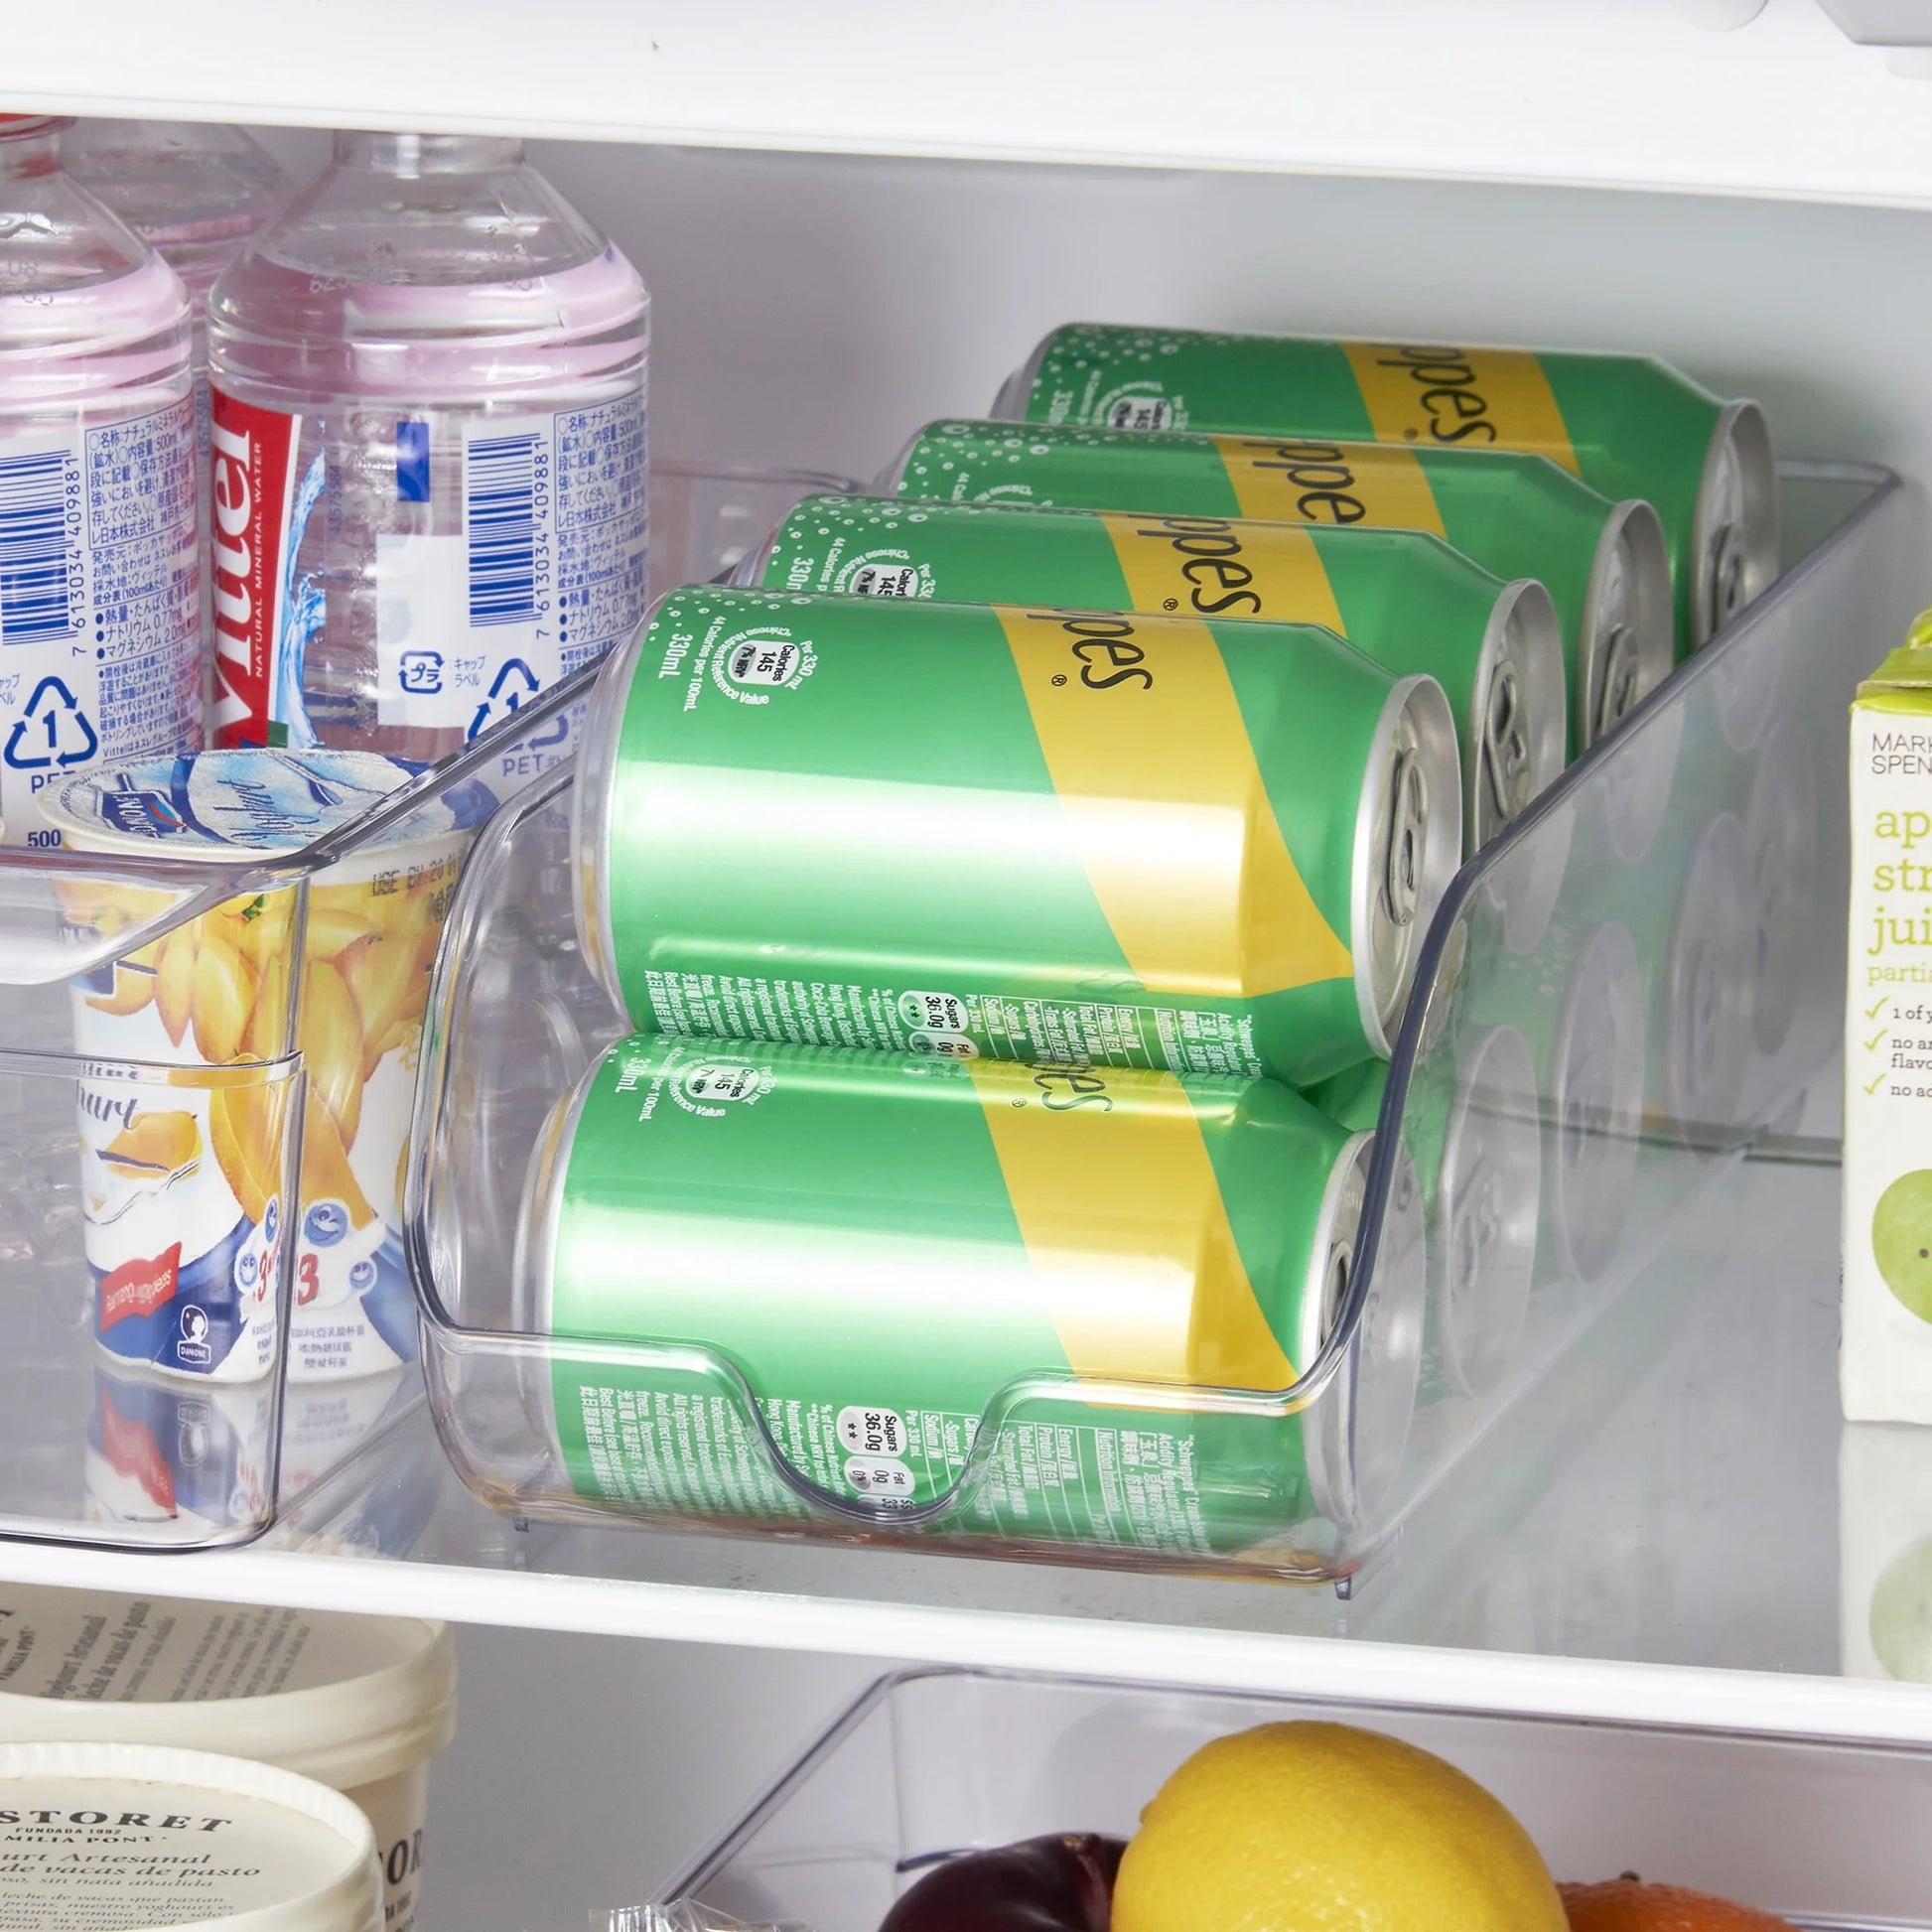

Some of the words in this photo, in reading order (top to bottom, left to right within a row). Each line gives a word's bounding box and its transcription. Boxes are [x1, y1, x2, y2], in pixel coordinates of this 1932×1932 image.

[253, 442, 263, 504] WATER
[534, 441, 549, 519] 409881
[65, 458, 82, 536] 409881
[254, 510, 264, 591] MINERAL
[535, 532, 550, 613] 613034
[69, 549, 86, 629] 613034
[106, 618, 151, 643] ナトリウム
[254, 596, 265, 679] NATURAL
[536, 628, 550, 639] 7
[698, 625, 722, 658] Calories
[72, 646, 86, 658] 7
[106, 631, 162, 658] マグネシウム
[658, 633, 693, 679] 330mL
[410, 661, 440, 683] プラ
[454, 655, 486, 672] キャップ
[693, 658, 706, 676] per
[757, 651, 777, 673] 145
[772, 645, 795, 682] Calories
[798, 654, 818, 677] 330
[455, 672, 482, 687] ラベル
[711, 659, 740, 700] Reference
[740, 691, 769, 705] Value
[683, 677, 703, 712] 100mL
[502, 754, 545, 777] PET
[28, 828, 63, 848] 500
[1874, 810, 1932, 849] ap
[1866, 905, 1932, 956] jui
[664, 971, 679, 988] Best
[718, 975, 739, 996] Avoid
[667, 988, 684, 1009] Before
[810, 982, 830, 1016] Coca-Cola
[828, 984, 844, 1002] Hong
[965, 994, 978, 1009] Per
[722, 995, 740, 1015] direct
[925, 996, 944, 1029] 36.0g
[945, 998, 961, 1030] Sugars
[984, 997, 1002, 1025] Sodium
[1078, 1006, 1096, 1024] Total
[1893, 1007, 1901, 1020] 1
[1905, 1004, 1924, 1021] of
[1098, 1006, 1116, 1033] Protein
[1891, 1038, 1914, 1049] no
[616, 1057, 651, 1093] 330mL
[715, 1073, 732, 1091] 145
[1890, 1085, 1913, 1097] no
[638, 1091, 661, 1122] 100mL
[695, 1104, 727, 1118] Value
[599, 1387, 614, 1407] Best
[635, 1390, 650, 1418] freeze.
[654, 1391, 671, 1416] Avoid
[673, 1392, 688, 1406] All
[766, 1398, 782, 1419] Hong
[602, 1408, 618, 1435] Before
[657, 1416, 673, 1441] direct
[671, 1406, 689, 1430] rights
[690, 1401, 711, 1442] registered
[711, 1396, 728, 1444] trademarks
[786, 1400, 807, 1455] Manufactured
[821, 1415, 834, 1424] of
[905, 1410, 918, 1427] Per
[604, 1435, 621, 1449] (see
[822, 1424, 836, 1454] Chinese
[865, 1413, 883, 1451] 36.0g
[885, 1415, 897, 1452] Sugars
[907, 1428, 921, 1447] 330
[924, 1414, 941, 1448] Sodium
[1018, 1425, 1034, 1447] Total
[1038, 1426, 1055, 1458] Protein
[716, 1444, 731, 1453] of
[810, 1444, 824, 1459] NRV
[910, 1446, 922, 1457] mL
[1021, 1448, 1035, 1462] Fat
[1057, 1428, 1074, 1459] Energy
[1098, 1432, 1116, 1470] Nutrition
[1158, 1433, 1174, 1467] Acidity
[873, 1470, 890, 1484] 0g
[894, 1471, 905, 1485] Fat
[0, 1810, 232, 1833] STORET
[61, 1852, 212, 1864] Artesanal
[0, 1863, 37, 1874] de
[46, 1866, 128, 1875] vacas
[136, 1865, 172, 1877] de
[179, 1866, 261, 1878] pasto
[40, 1875, 69, 1884] sin
[76, 1877, 122, 1886] nata
[52, 1892, 72, 1901] de
